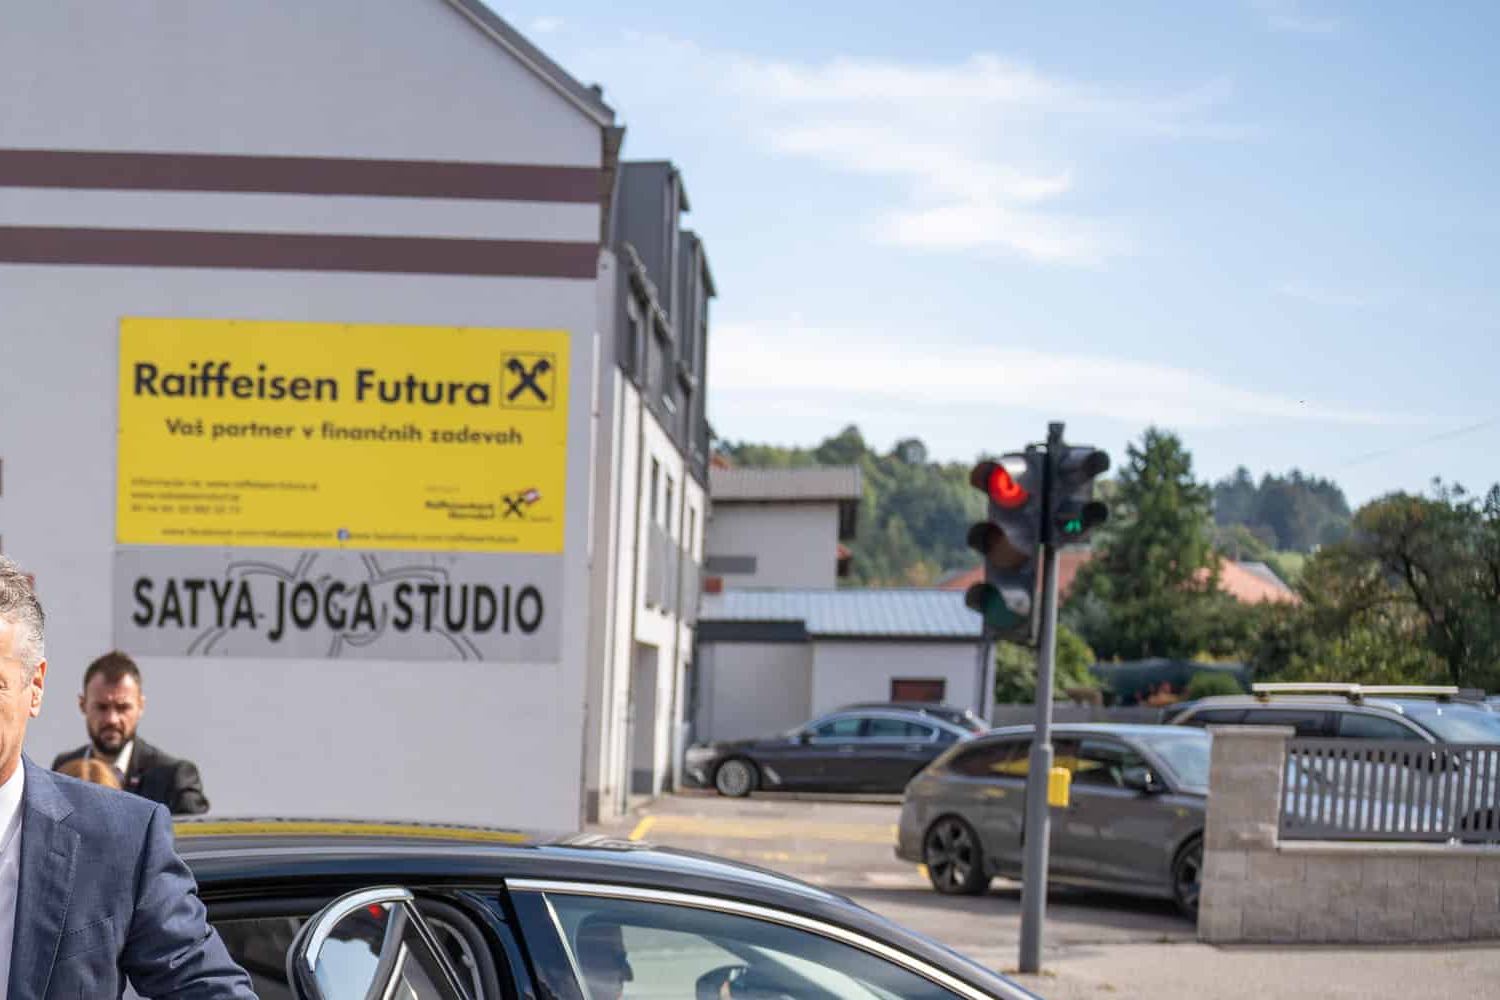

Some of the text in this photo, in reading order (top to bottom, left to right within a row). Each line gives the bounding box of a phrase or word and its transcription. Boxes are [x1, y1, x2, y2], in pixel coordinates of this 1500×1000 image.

[133, 363, 492, 406] Raiffeisen Futura
[166, 418, 522, 445] Vaš partner v finančnih zadevah
[132, 577, 545, 642] SATYA JOGA STUDIO
